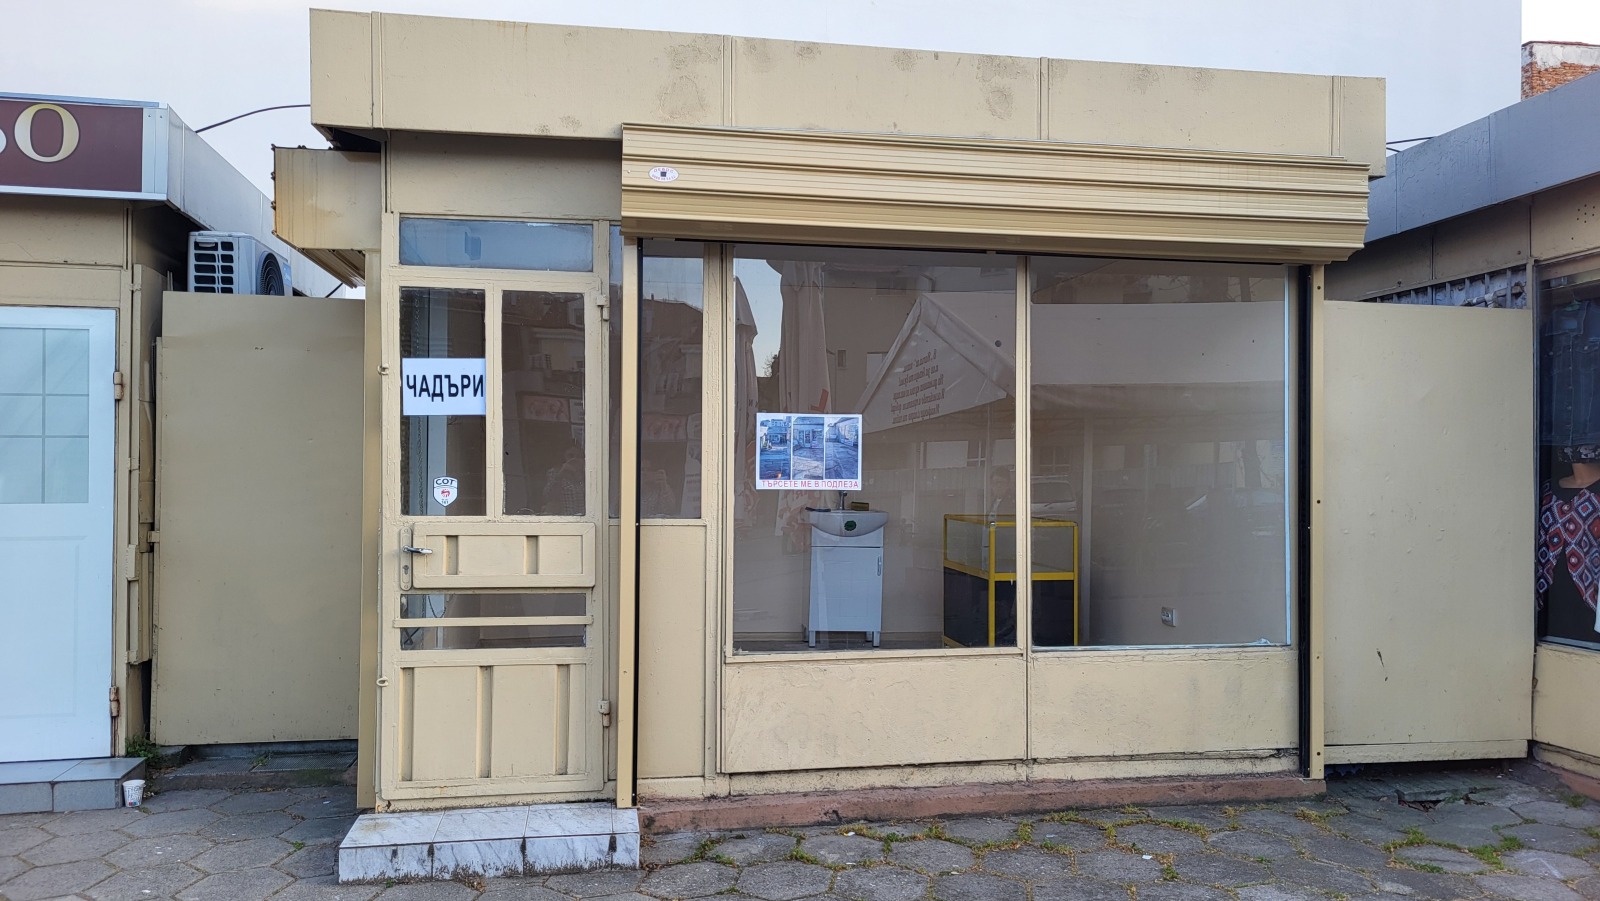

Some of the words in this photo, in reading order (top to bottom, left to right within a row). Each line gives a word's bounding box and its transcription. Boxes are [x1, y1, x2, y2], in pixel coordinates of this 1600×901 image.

[405, 374, 484, 402] ЧАДЪРИ
[762, 480, 798, 488] ТЪРСЕТЕ
[800, 480, 812, 488] МЕ
[814, 480, 820, 488] В
[821, 480, 859, 489] ПОДЛЕЗА
